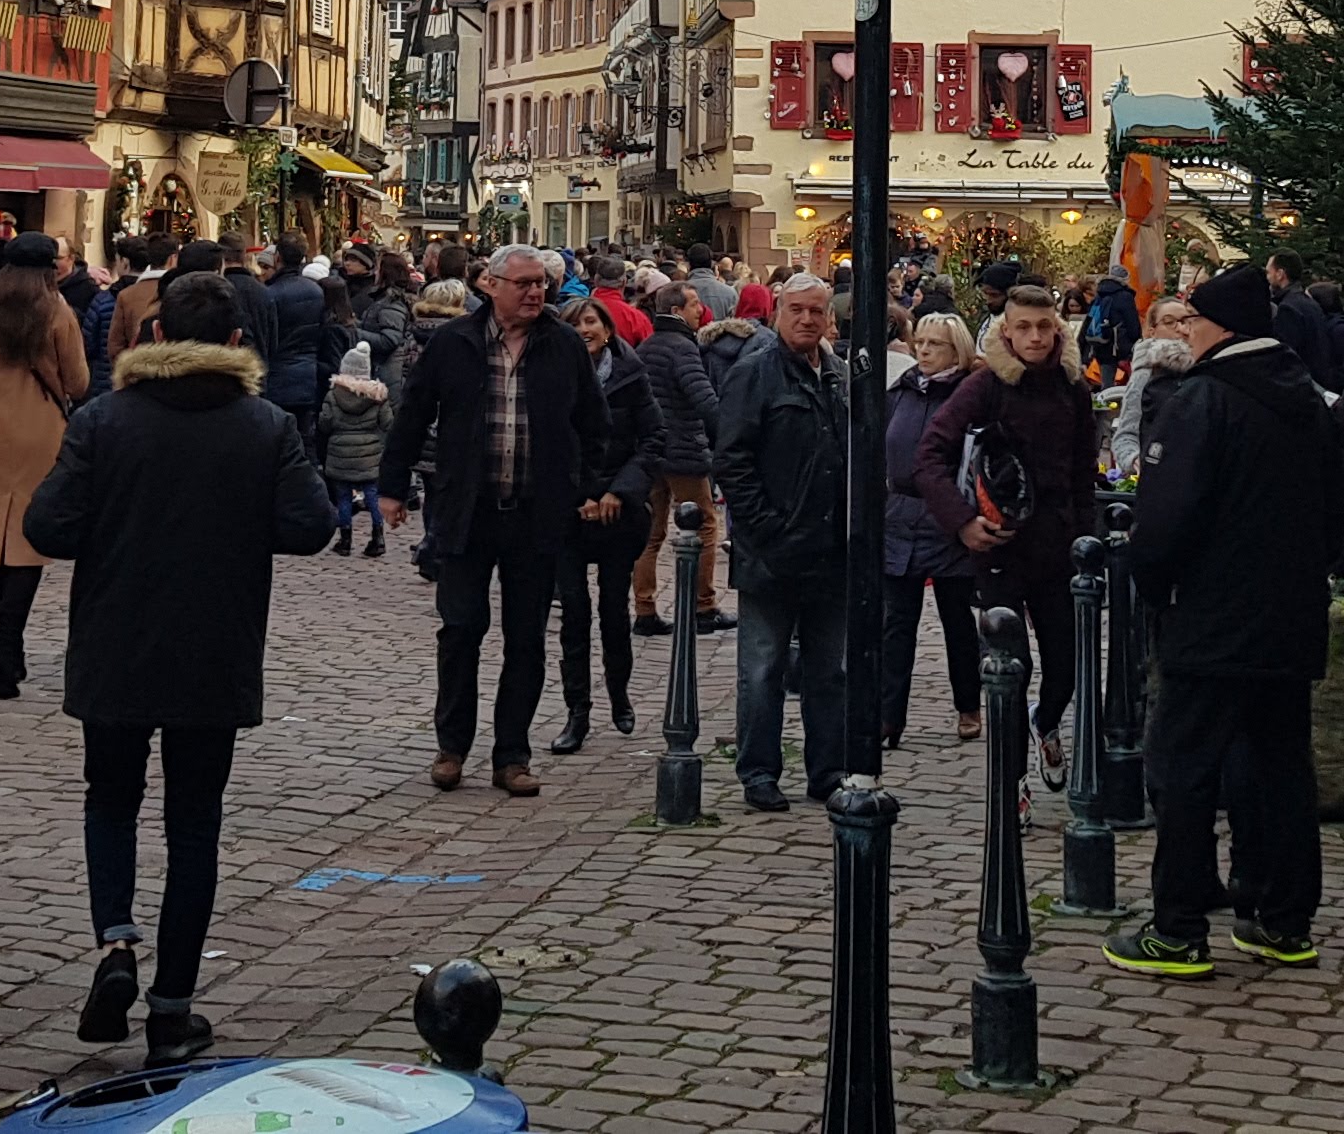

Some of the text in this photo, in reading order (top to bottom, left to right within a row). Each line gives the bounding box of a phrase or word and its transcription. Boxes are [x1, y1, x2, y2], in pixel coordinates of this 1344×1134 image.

[957, 149, 997, 169] La
[1002, 149, 1059, 169] Table
[1067, 152, 1095, 170] du
